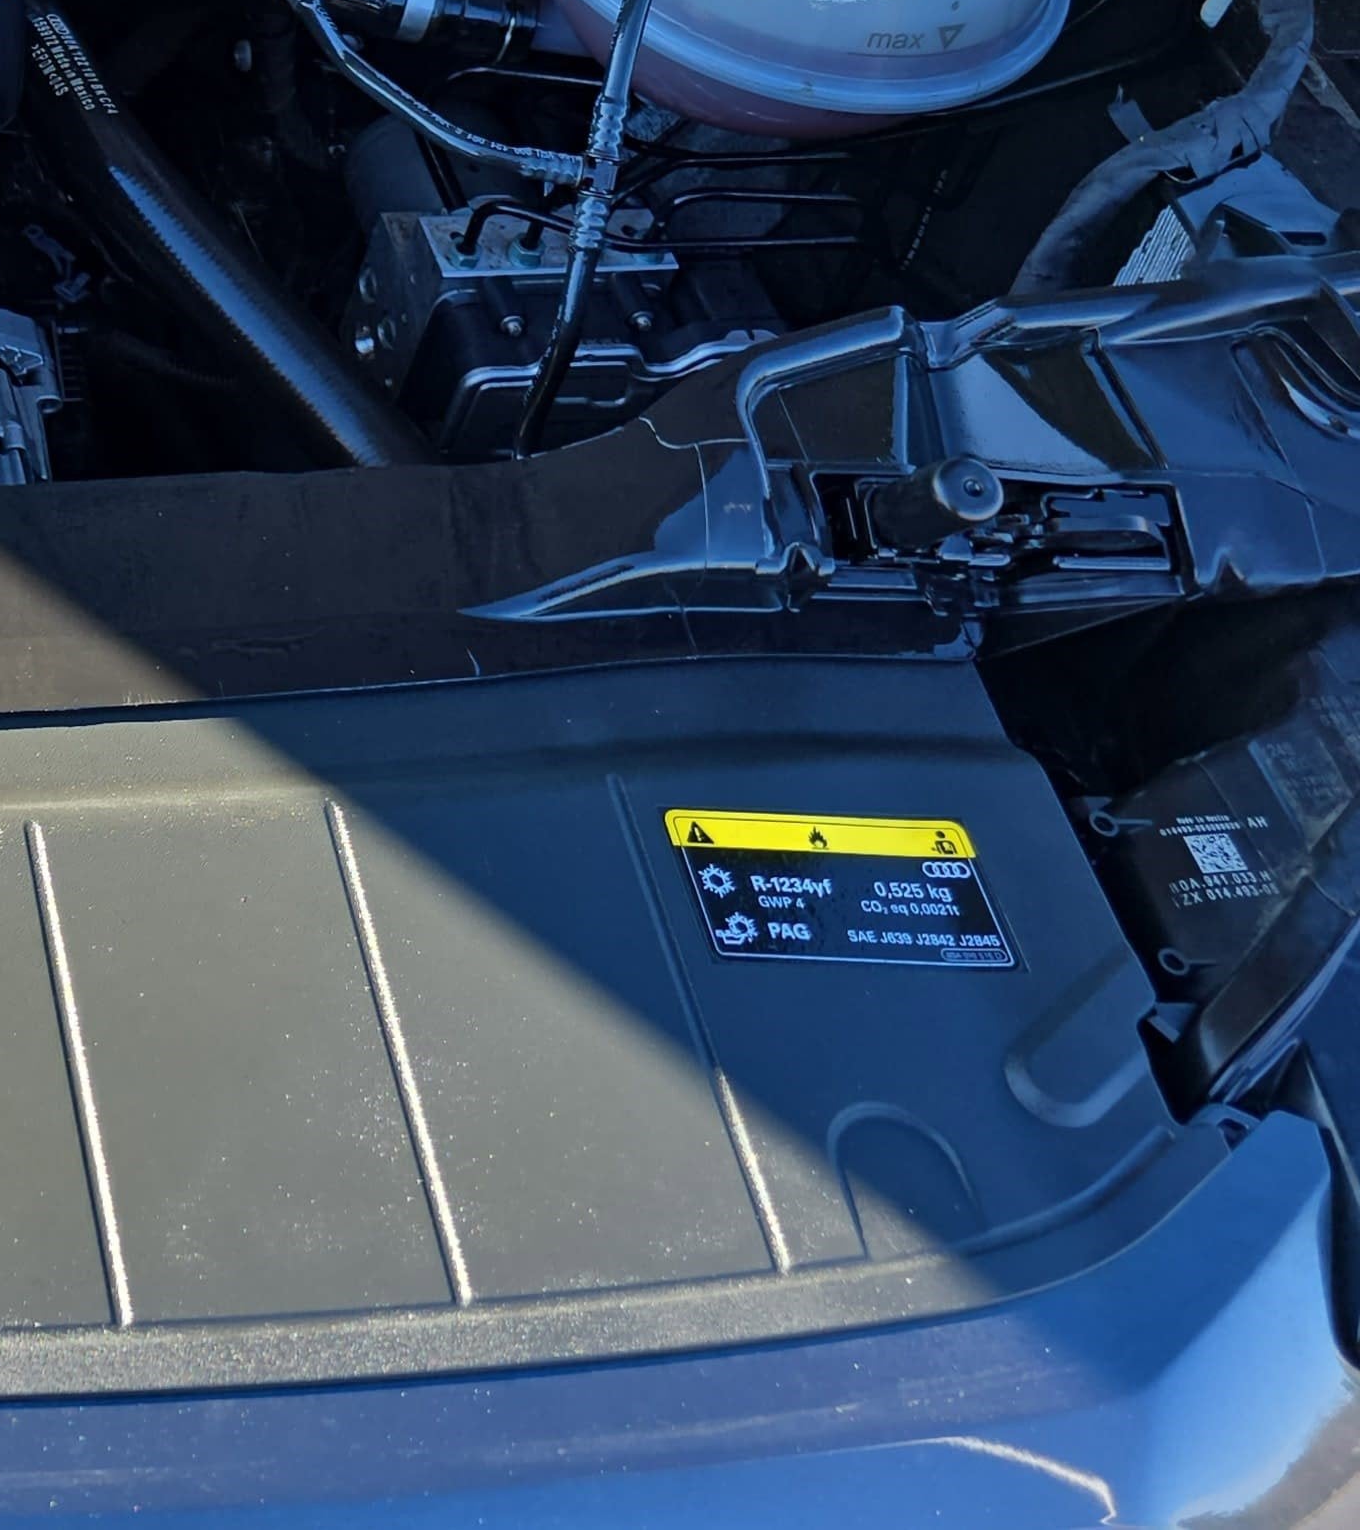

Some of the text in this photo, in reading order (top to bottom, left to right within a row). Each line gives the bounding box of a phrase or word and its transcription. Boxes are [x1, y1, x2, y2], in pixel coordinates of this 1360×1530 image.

[866, 30, 924, 50] max
[750, 875, 832, 898] R-1234yf
[873, 881, 952, 902] 0,525 kg
[758, 895, 804, 908] GWP 4
[890, 902, 909, 916] eq
[767, 921, 812, 940] PAG
[846, 929, 1000, 947] SAE J639 J2842 J2845
